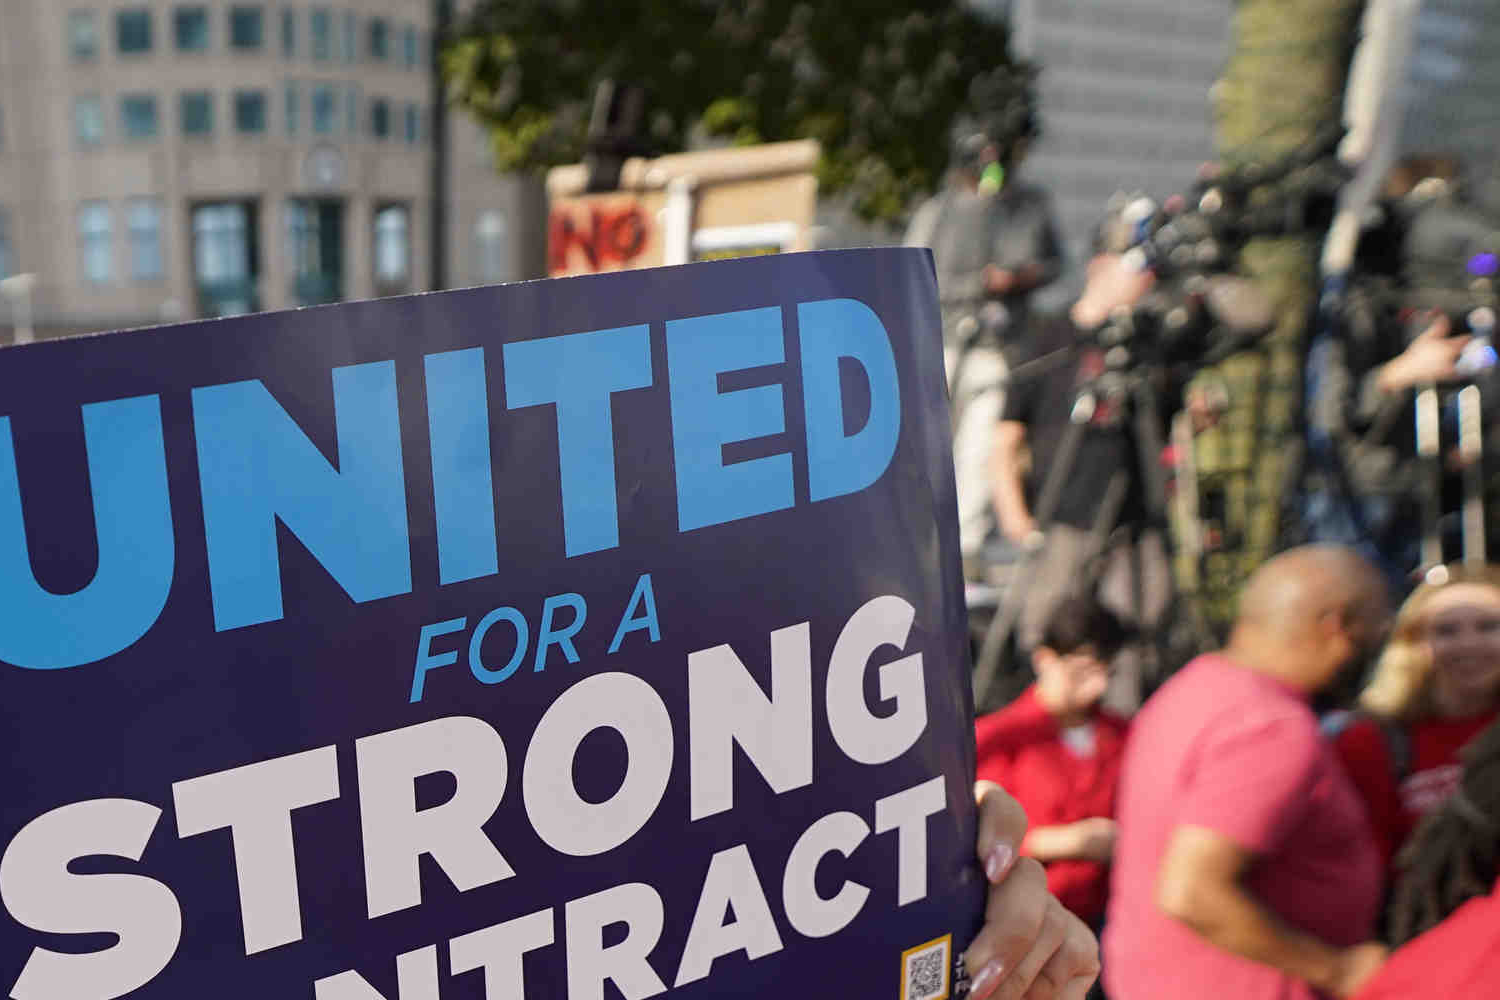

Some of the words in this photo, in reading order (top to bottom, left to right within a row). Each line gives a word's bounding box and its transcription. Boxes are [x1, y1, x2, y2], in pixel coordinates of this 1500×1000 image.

[548, 200, 648, 274] NO
[409, 592, 587, 704] FOR
[607, 573, 661, 655] A
